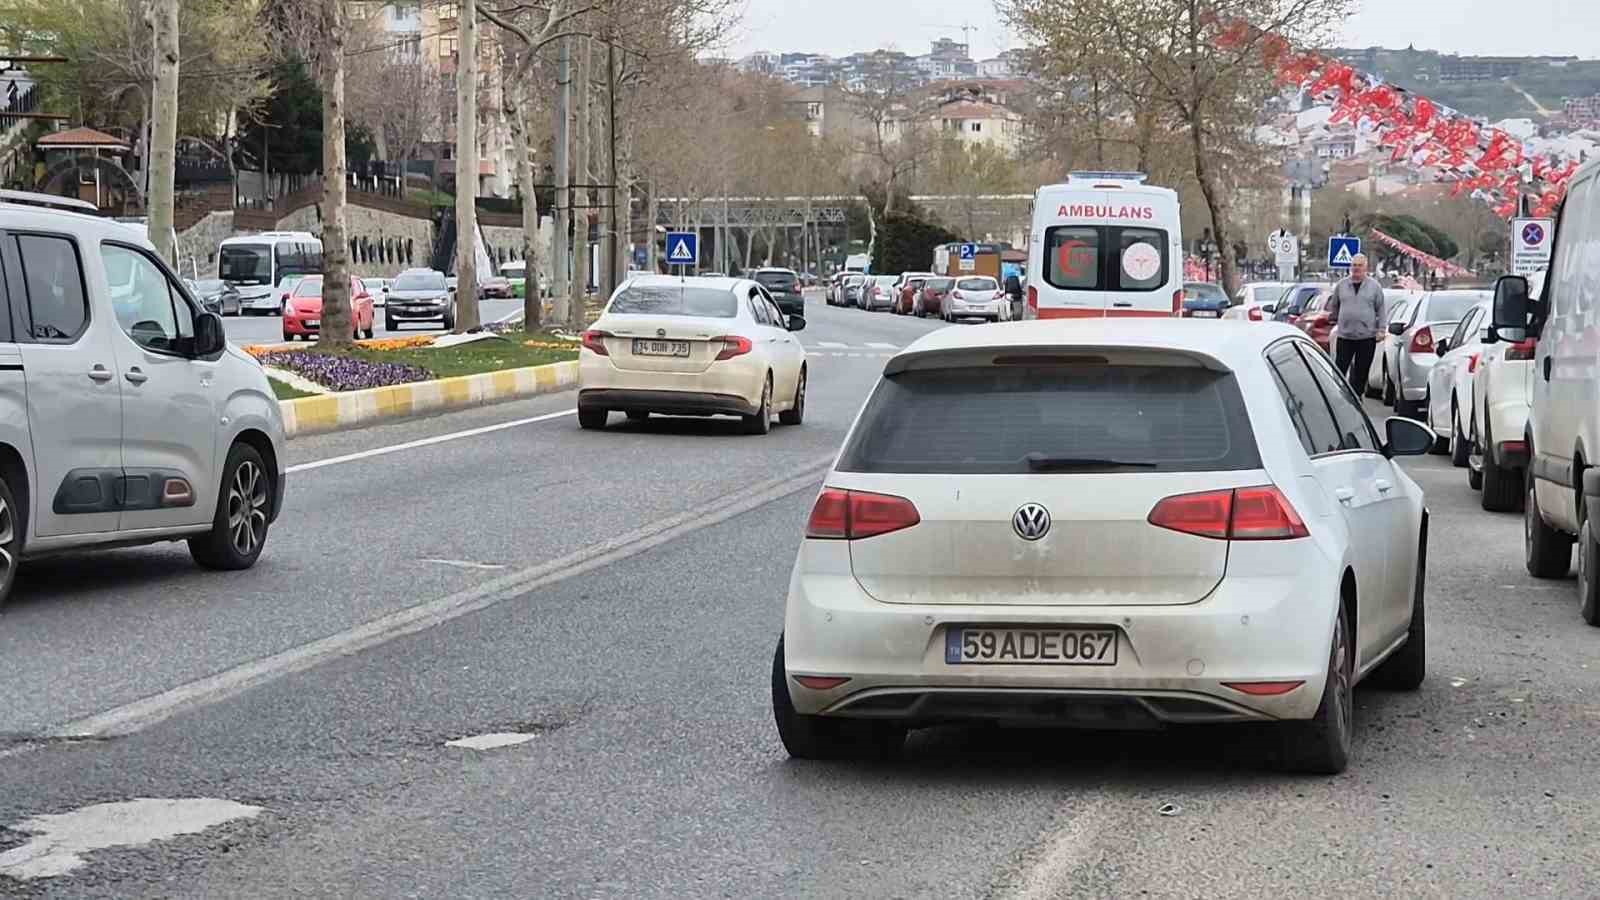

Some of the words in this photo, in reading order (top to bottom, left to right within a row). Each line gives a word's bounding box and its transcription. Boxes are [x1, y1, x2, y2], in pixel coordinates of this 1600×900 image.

[1057, 205, 1153, 219] AMBULANS
[961, 245, 970, 258] P
[963, 631, 1114, 660] 59ADE067
